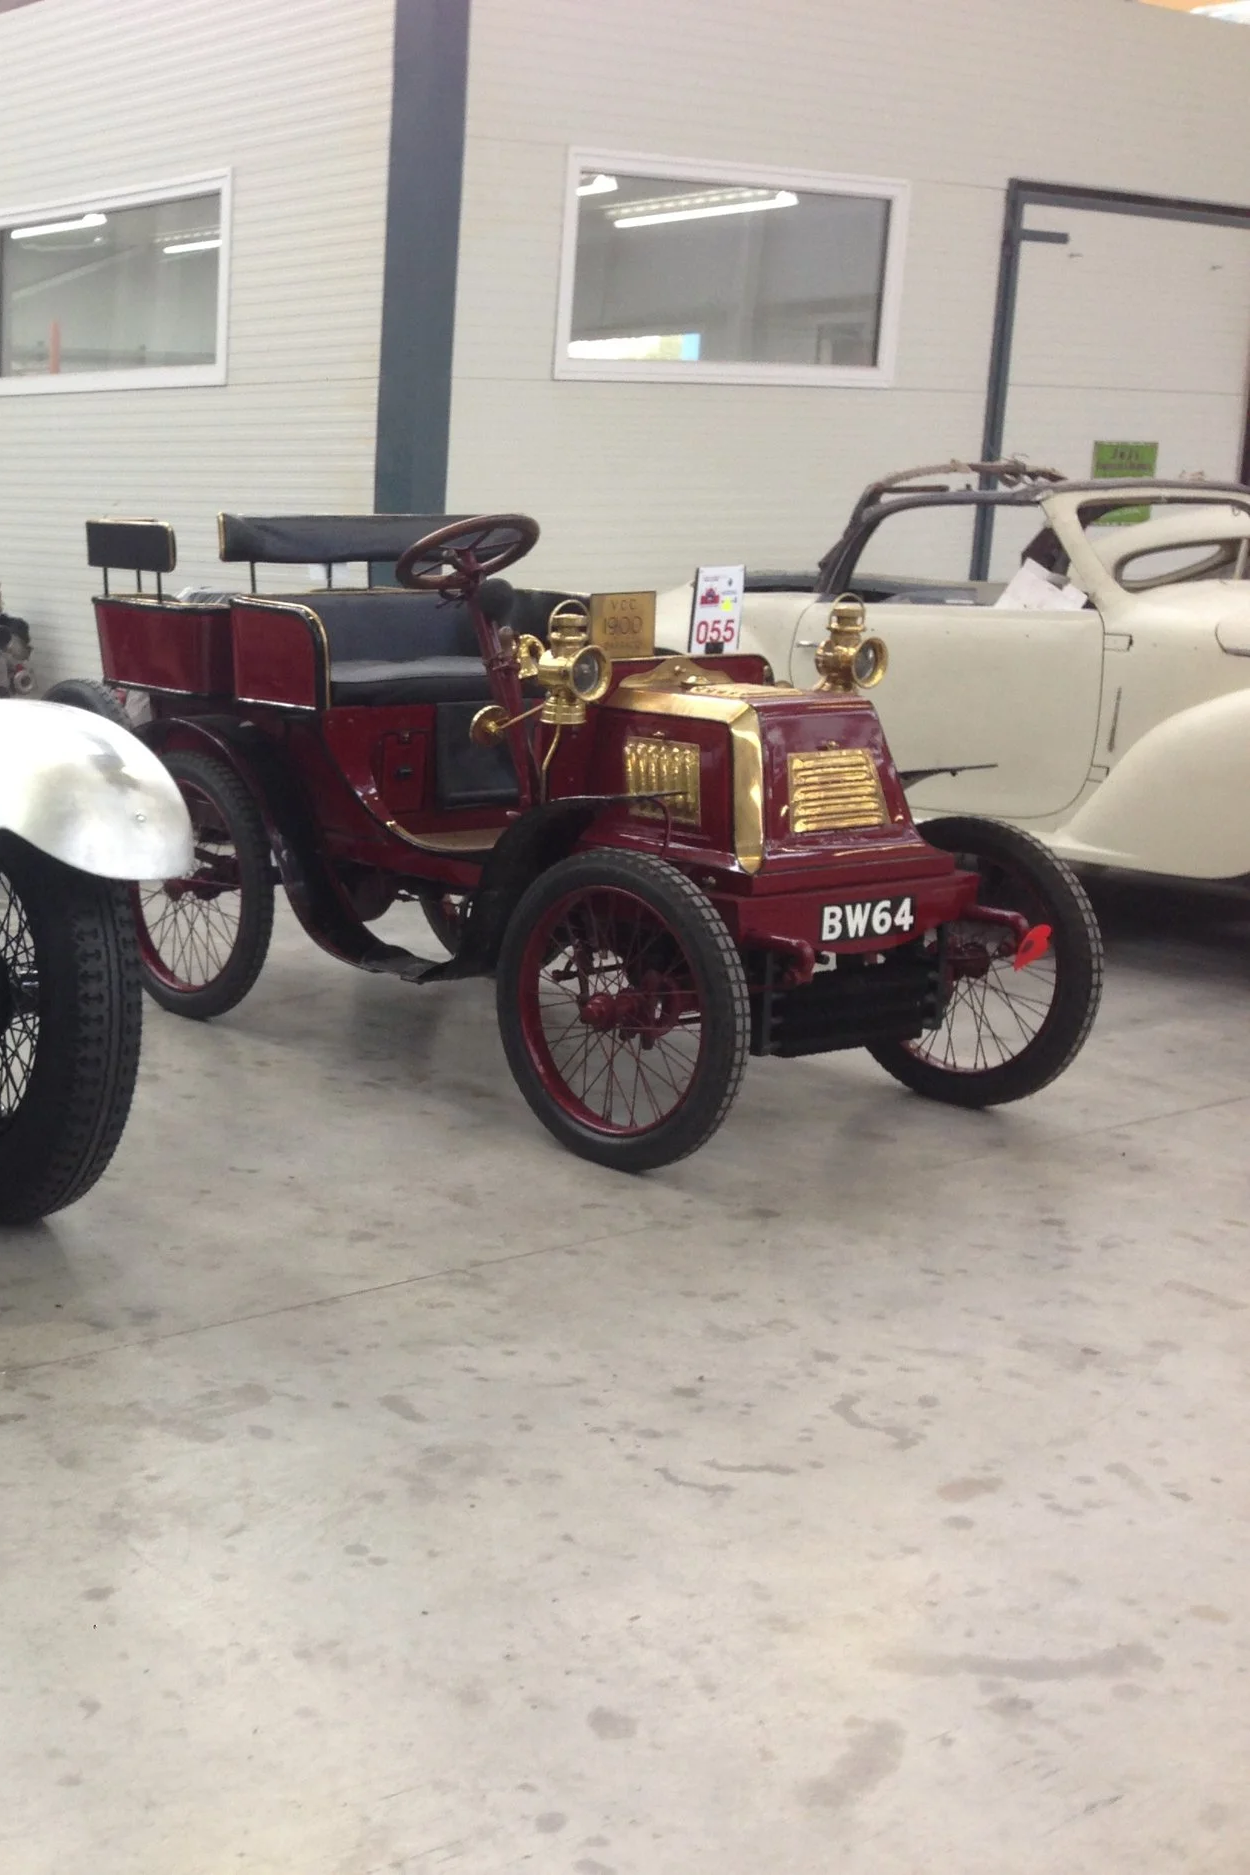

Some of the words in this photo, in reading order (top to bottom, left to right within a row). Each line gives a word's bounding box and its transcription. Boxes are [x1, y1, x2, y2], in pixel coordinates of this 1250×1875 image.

[603, 615, 643, 636] 1900
[696, 619, 735, 644] 055
[821, 897, 914, 941] BW64
